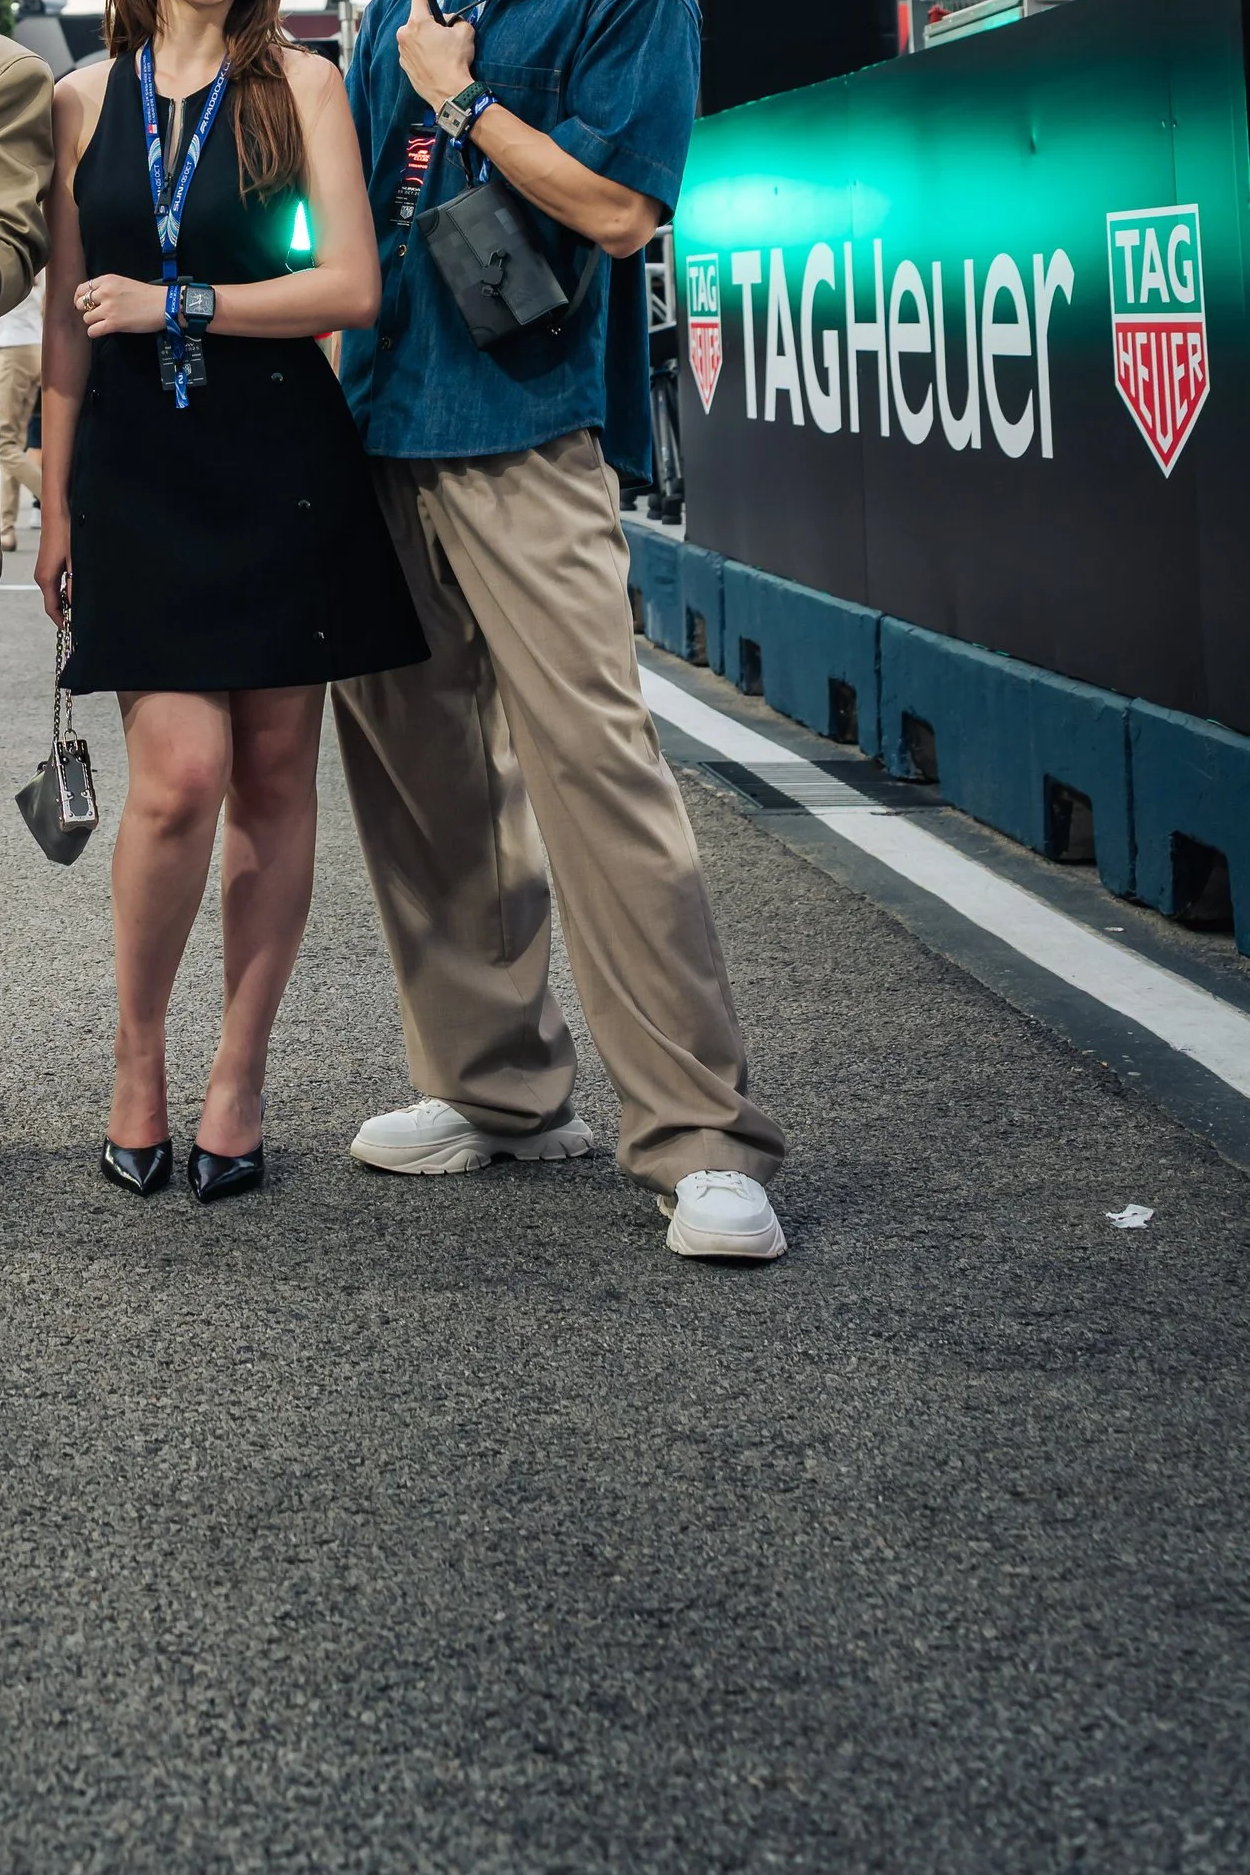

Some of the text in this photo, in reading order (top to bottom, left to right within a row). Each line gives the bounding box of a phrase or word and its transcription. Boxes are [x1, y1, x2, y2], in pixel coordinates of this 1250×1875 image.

[204, 71, 226, 120] PADDOCK
[689, 264, 717, 313] TAG
[1114, 224, 1197, 306] TAG
[1117, 329, 1205, 455] HEUER
